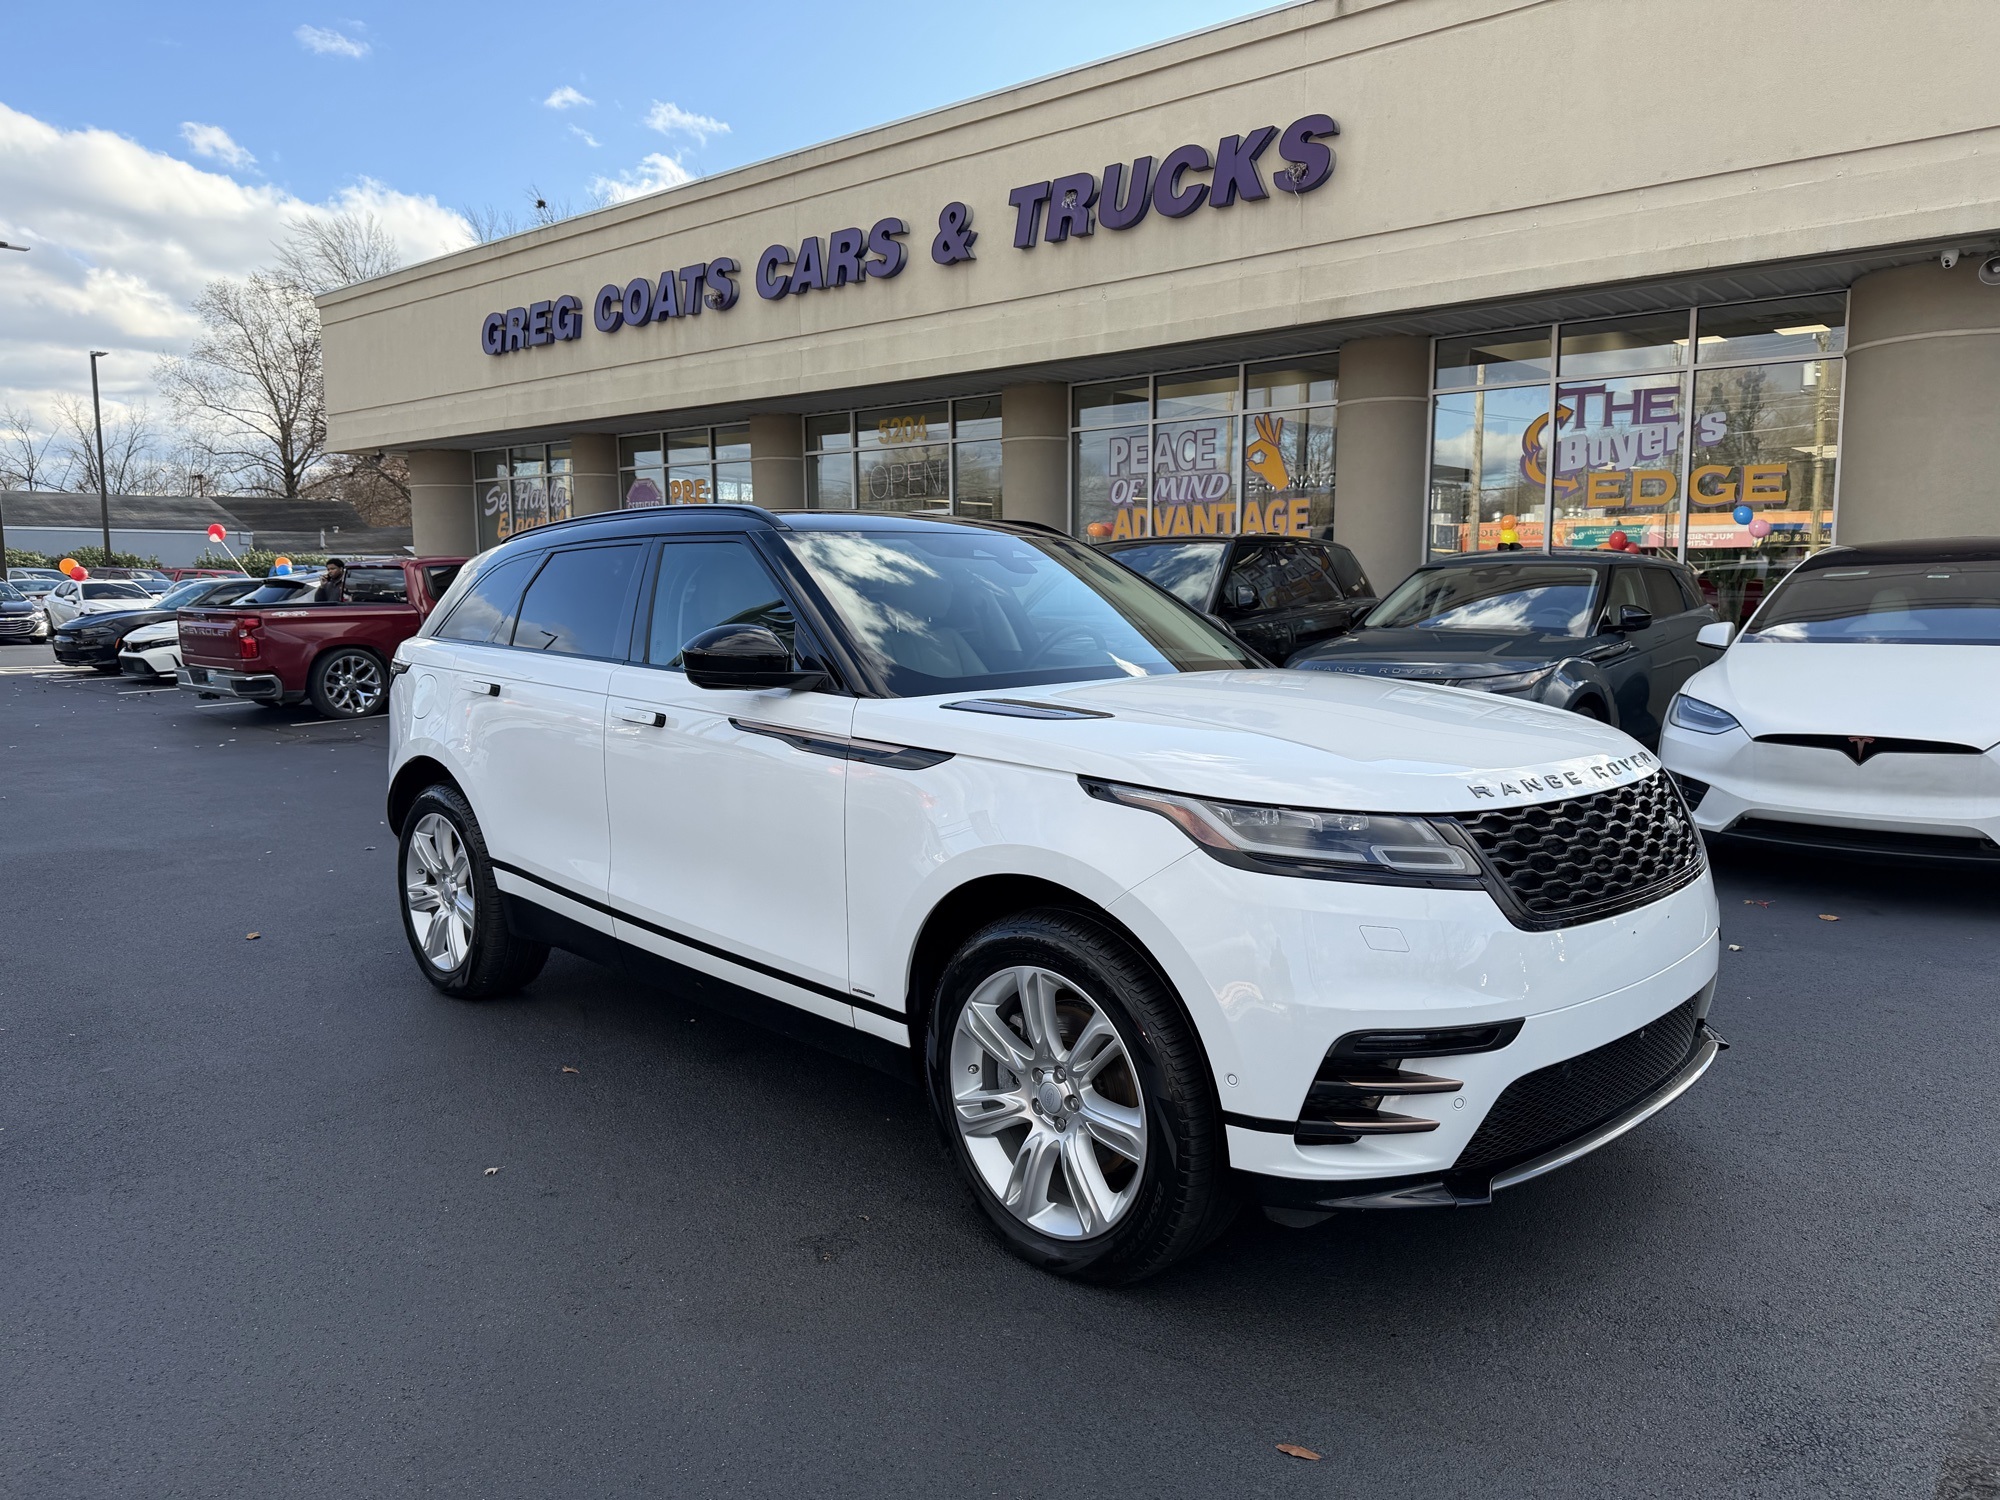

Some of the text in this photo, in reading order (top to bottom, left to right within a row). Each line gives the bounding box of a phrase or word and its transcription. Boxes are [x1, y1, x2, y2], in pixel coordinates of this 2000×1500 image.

[481, 113, 1340, 356] GREG COATS CARS & TRUCKS
[1557, 384, 1681, 431] THE
[878, 415, 928, 445] 5204
[1557, 412, 1728, 473] Buyer's
[1109, 428, 1216, 477] PEACE
[669, 478, 711, 505] PRE-
[870, 461, 942, 499] OPEN
[1111, 479, 1145, 504] OF
[1153, 473, 1232, 501] MIND
[1585, 463, 1791, 509] EDGE
[484, 485, 508, 517] Se
[1111, 497, 1312, 539] ADVANTAGE
[179, 625, 232, 637] CHEVROLET
[1312, 665, 1443, 675] RANGE ROVER
[1467, 751, 1652, 799] RANGE ROVER
